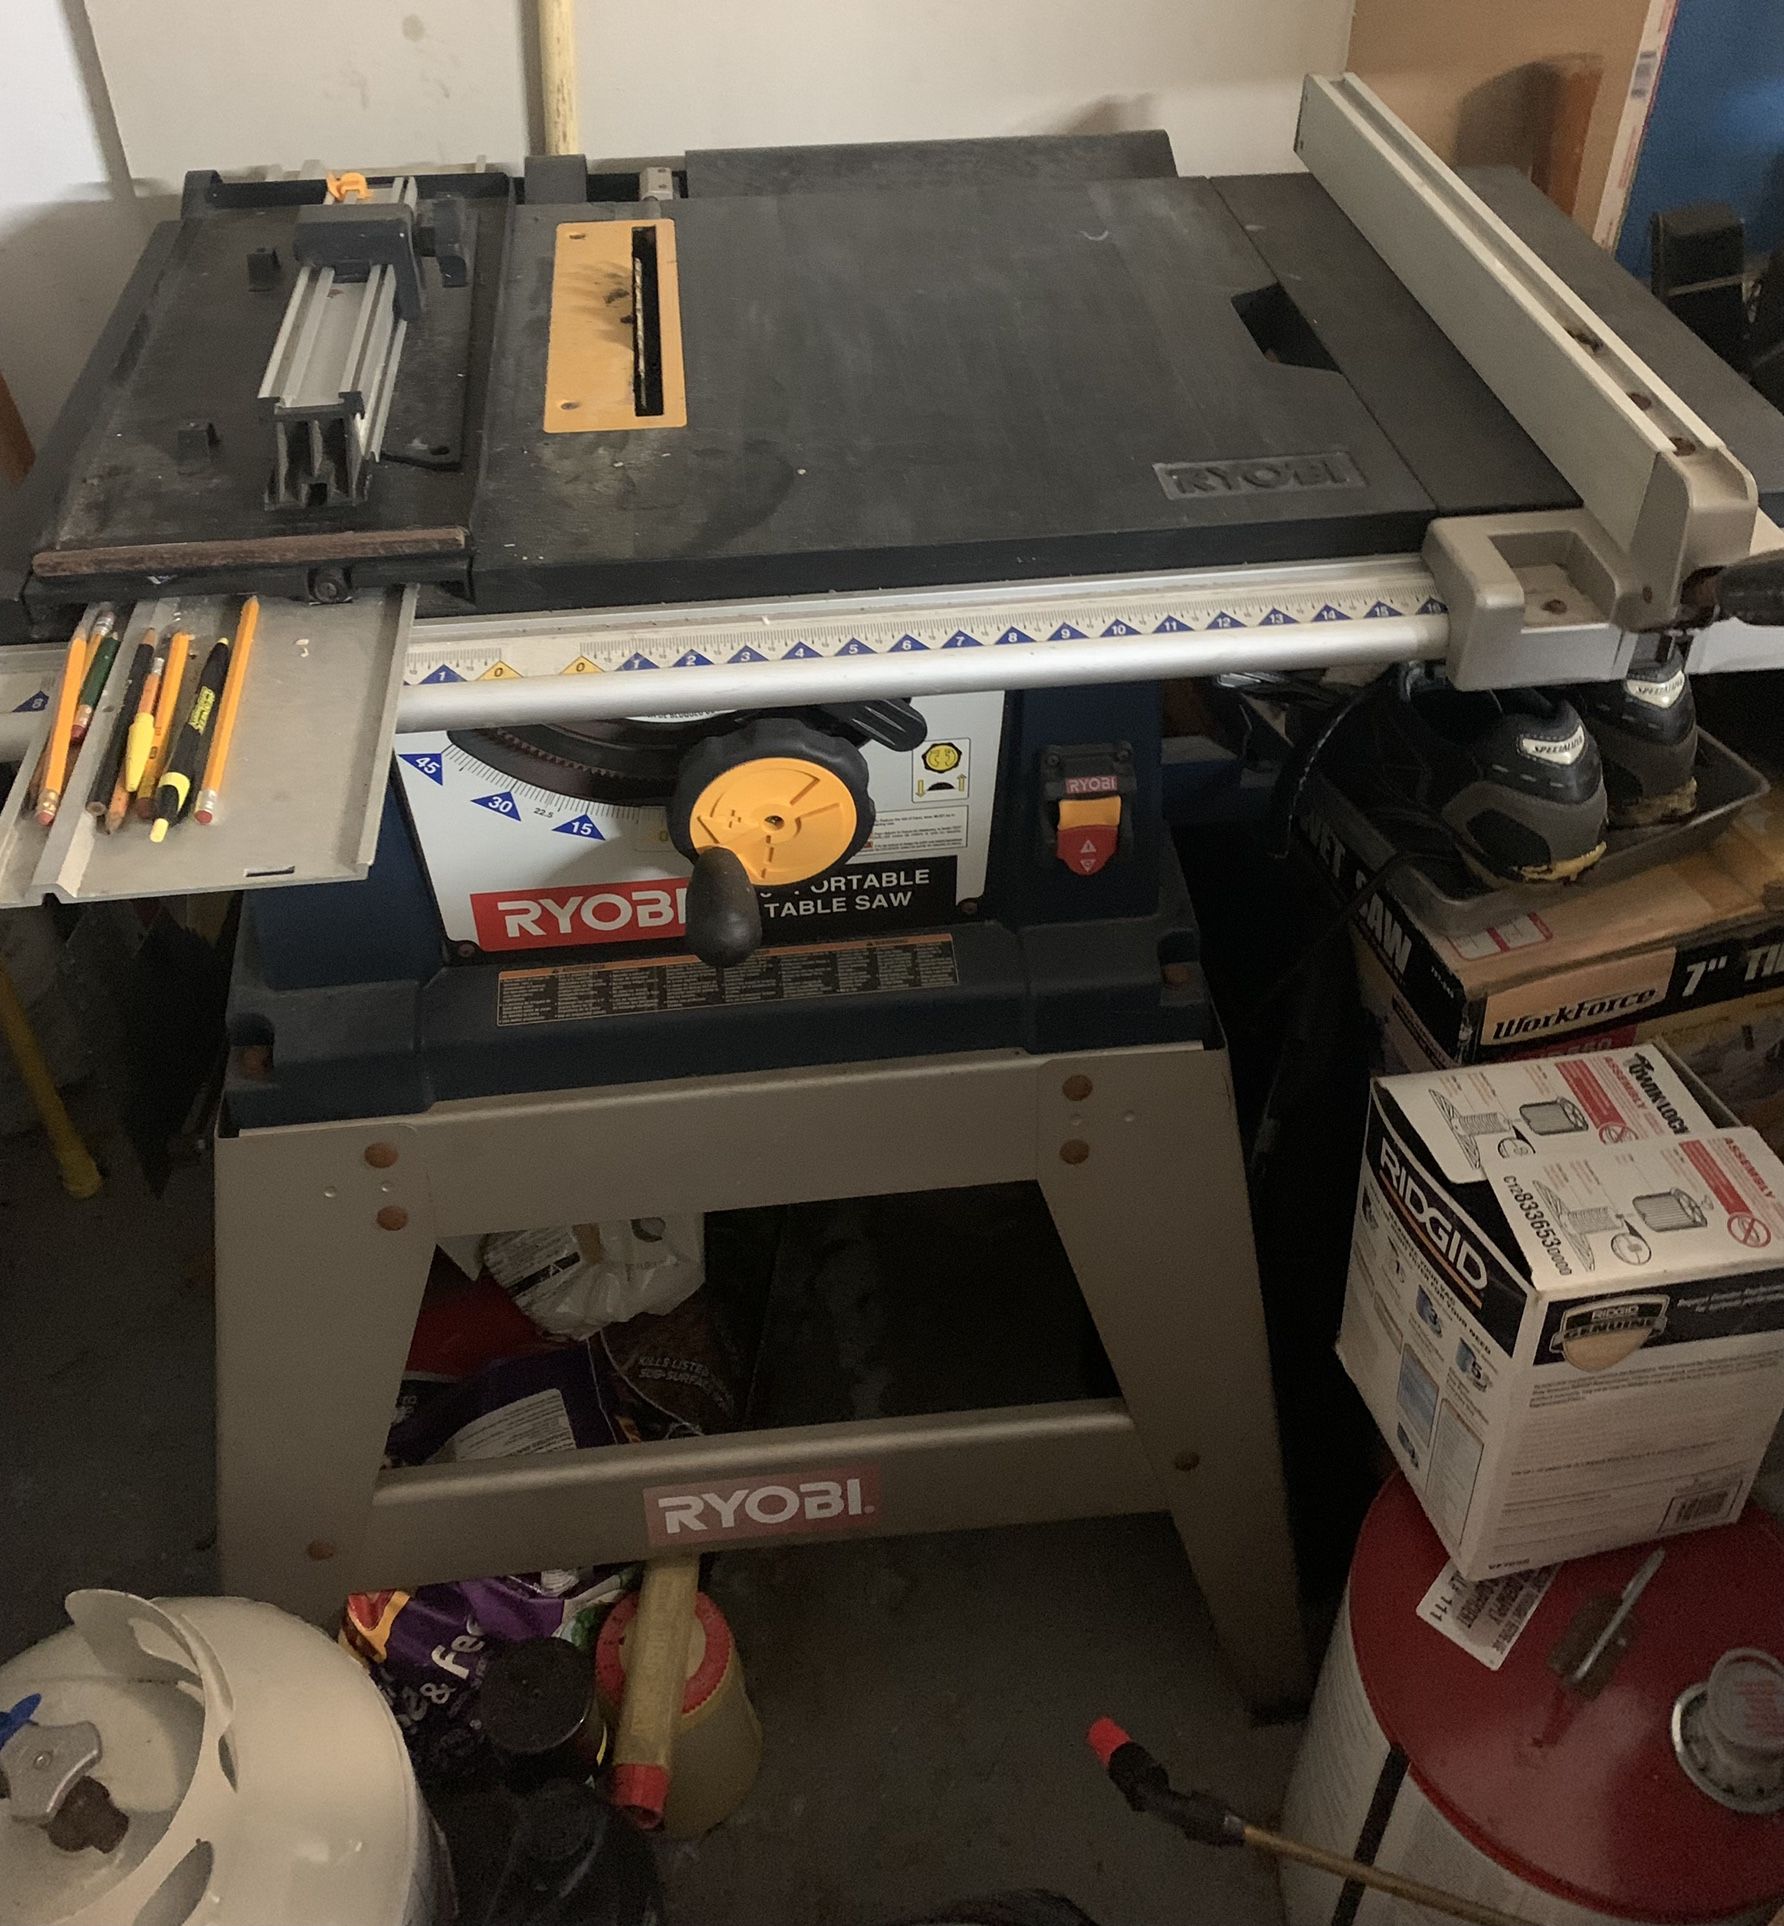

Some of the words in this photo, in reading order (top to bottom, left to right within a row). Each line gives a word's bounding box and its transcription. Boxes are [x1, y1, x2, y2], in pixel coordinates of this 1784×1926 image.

[1165, 460, 1349, 494] RYOBI
[632, 659, 641, 670] 1
[685, 655, 697, 666] 2
[740, 651, 752, 662] 3
[795, 648, 805, 658] 4
[849, 644, 859, 655] 5
[902, 640, 912, 650] 6
[955, 636, 965, 647] 7
[1008, 632, 1018, 643] 8
[1060, 628, 1071, 639] 9
[1111, 625, 1127, 635] 10
[1165, 621, 1177, 631] 11
[1217, 617, 1231, 628] 12
[1270, 614, 1284, 624] 13
[1322, 610, 1336, 620] 14
[1374, 606, 1389, 616] 15
[415, 756, 440, 775] 45
[1067, 777, 1117, 794] RYOBI
[488, 796, 512, 815] 30
[533, 807, 554, 819] 22.5
[571, 820, 593, 836] 15
[794, 869, 930, 896] ORTABLE
[764, 898, 848, 918] TABLE
[855, 891, 913, 912] SAW
[1724, 1137, 1776, 1200] ASSEMBLY
[1379, 1138, 1488, 1291] RIDGID
[658, 1479, 862, 1534] RYOBI
[419, 1681, 456, 1705] &
